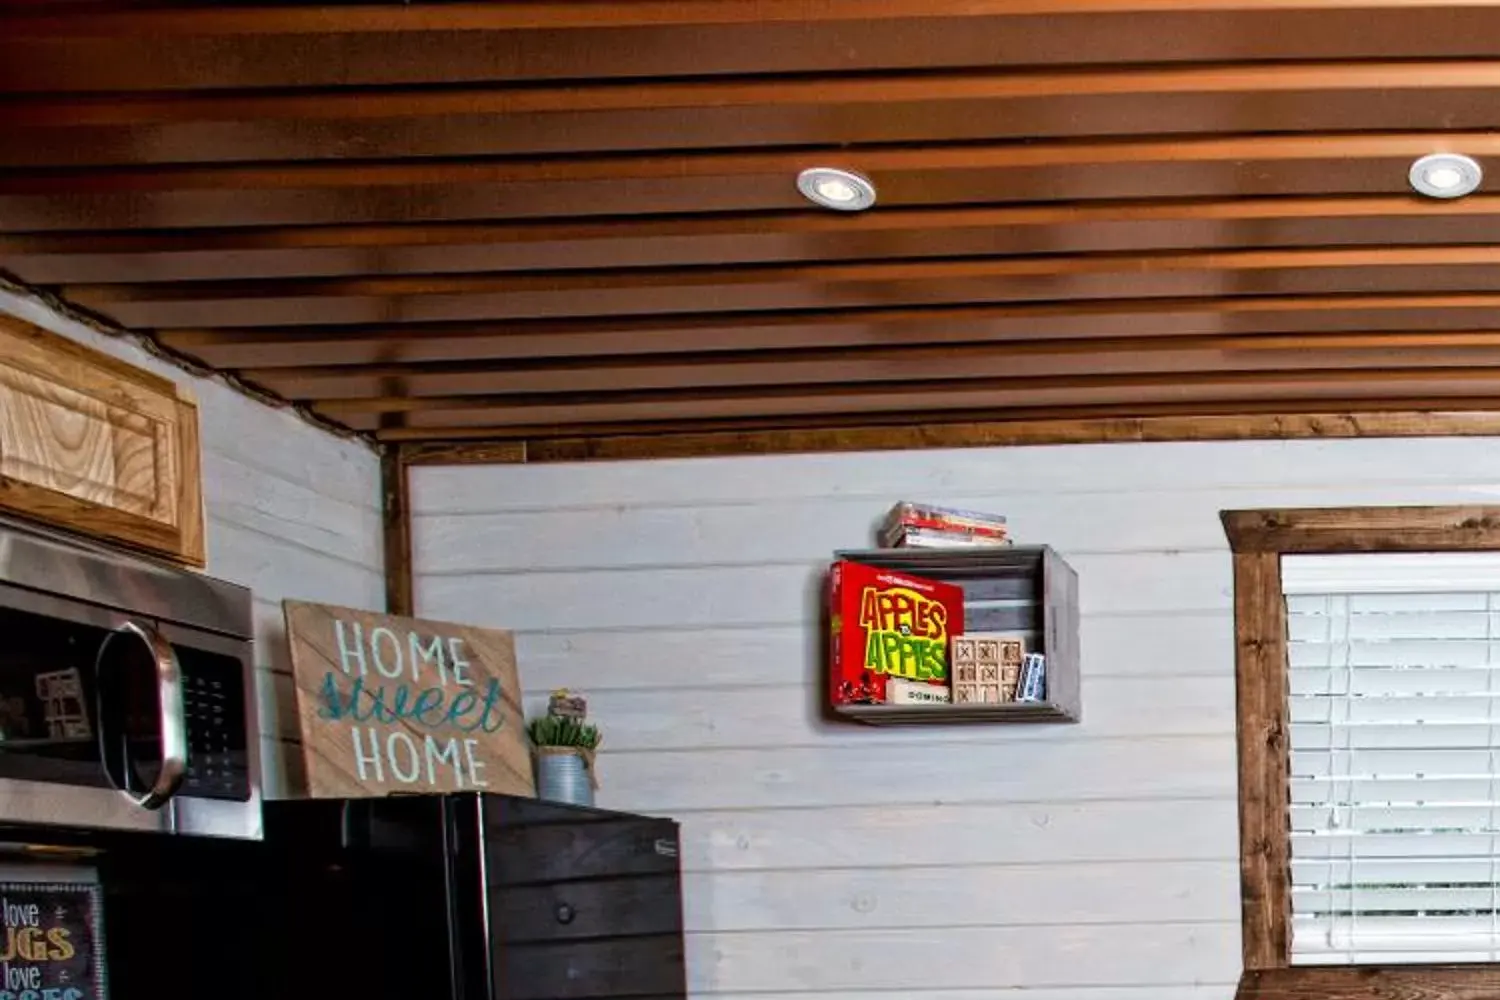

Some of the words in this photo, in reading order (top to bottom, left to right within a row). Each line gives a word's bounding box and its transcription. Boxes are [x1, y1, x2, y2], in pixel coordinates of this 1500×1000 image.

[860, 587, 947, 640] APPLES
[334, 617, 476, 687] HOME
[864, 631, 947, 679] APPLES
[317, 671, 507, 733] sweet
[351, 726, 489, 788] HOME
[3, 897, 40, 927] love
[4, 961, 41, 990] love
